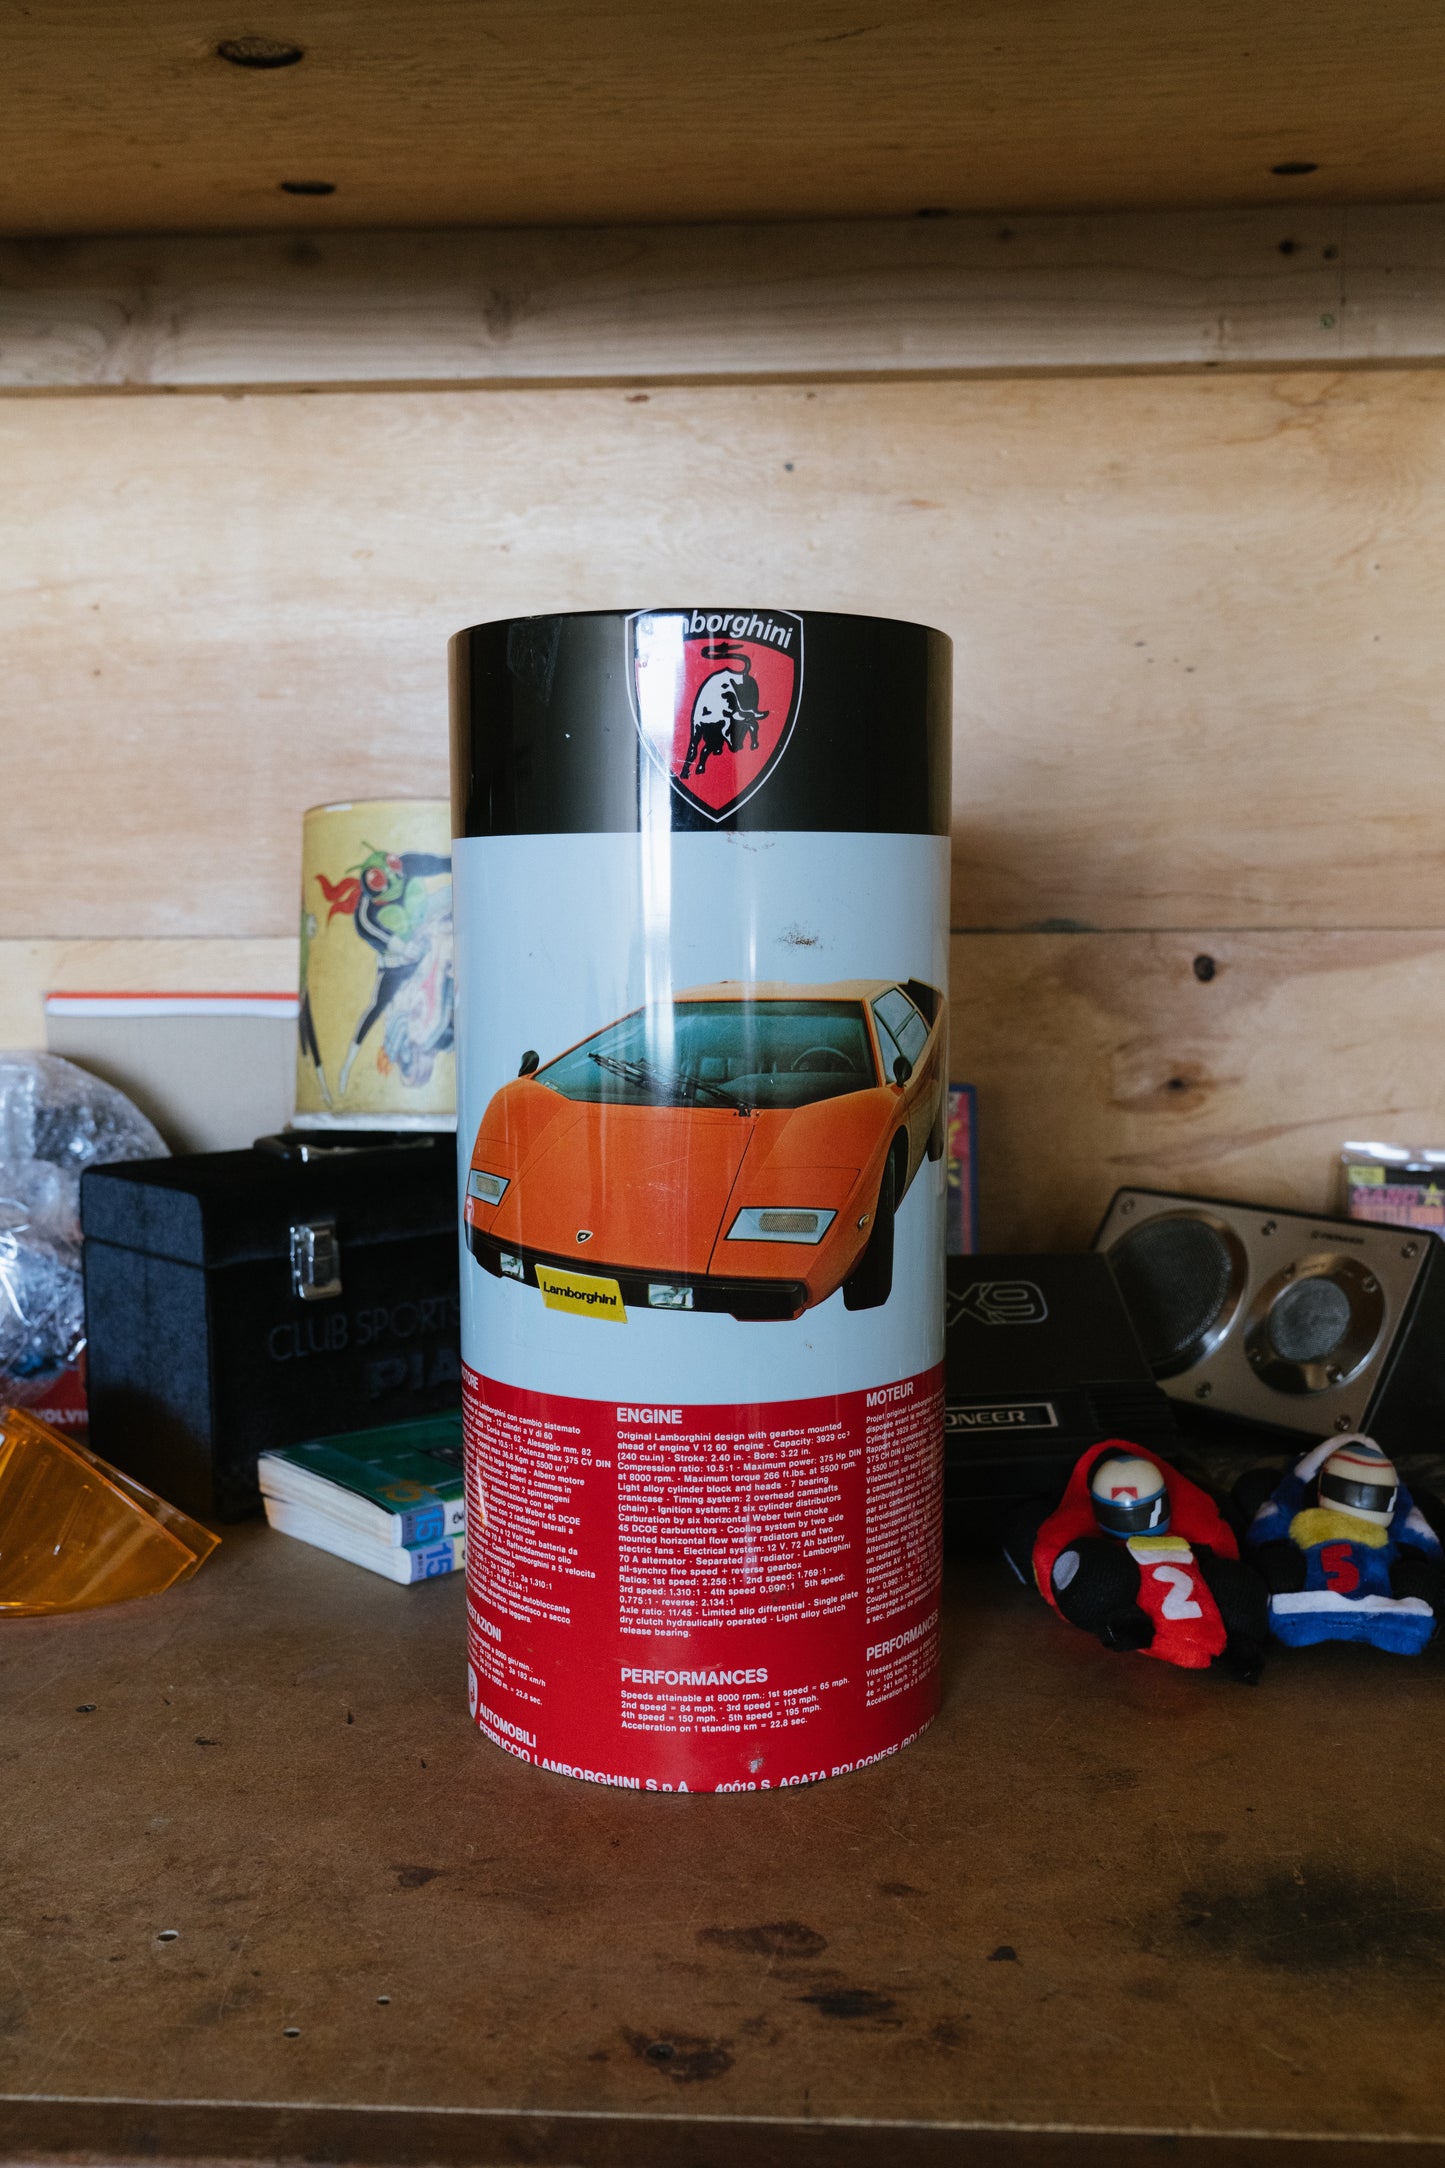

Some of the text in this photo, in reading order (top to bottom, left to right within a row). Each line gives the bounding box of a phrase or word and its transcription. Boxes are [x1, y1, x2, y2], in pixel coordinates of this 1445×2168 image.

[543, 1281, 617, 1305] Lamborghini
[268, 1312, 348, 1361] CLUB
[866, 1381, 913, 1407] MOTEUR
[617, 1407, 682, 1424] ENGINE
[617, 1422, 841, 1442] Original Lamborghini design with gearbox mounted
[617, 1442, 644, 1450] ahead
[703, 1443, 712, 1451] 12
[715, 1443, 726, 1451] 60
[733, 1442, 764, 1451] engine
[816, 1433, 834, 1443] 3929
[519, 1445, 545, 1458] Potenza
[564, 1455, 578, 1464] 375
[580, 1457, 592, 1466] CV
[596, 1459, 611, 1468] DIN
[617, 1462, 675, 1472] Compression
[743, 1462, 786, 1470] Maximum
[819, 1454, 833, 1463] 375
[836, 1452, 846, 1460] Hp
[849, 1448, 861, 1457] DIN
[533, 1469, 584, 1485] Albero motore
[629, 1473, 651, 1482] 8000
[731, 1474, 760, 1482] torque
[763, 1471, 779, 1480] 266
[820, 1463, 838, 1473] 5500
[617, 1482, 640, 1491] Light
[643, 1484, 664, 1493] alloy
[667, 1485, 703, 1493] cylinder
[735, 1483, 751, 1492] and
[755, 1482, 781, 1490] heads
[798, 1476, 828, 1486] bearing
[618, 1494, 663, 1502] crankcase
[673, 1495, 703, 1504] Timing
[746, 1494, 750, 1502] 2
[754, 1491, 794, 1501] overhead
[797, 1485, 838, 1497] camshafts
[658, 1505, 692, 1514] Ignition
[734, 1505, 739, 1513] 2
[742, 1504, 755, 1512] six
[758, 1501, 793, 1511] cylinder
[795, 1494, 841, 1507] distributors
[415, 1507, 443, 1541] 15
[618, 1513, 670, 1523] Carburation
[673, 1516, 684, 1524] by
[688, 1516, 700, 1524] six
[704, 1514, 749, 1524] horizontal
[752, 1513, 780, 1521] Weber
[804, 1507, 828, 1516] choke
[426, 1543, 452, 1578] 15
[1320, 1543, 1359, 1594] 5
[1152, 1565, 1203, 1620] 2
[620, 1626, 651, 1635] release
[866, 1608, 938, 1661] PERFORMANCES
[621, 1667, 768, 1685] PERFORMANCES
[621, 1690, 653, 1700] Speeds
[656, 1694, 701, 1702] attainable
[717, 1693, 739, 1702] 8000
[768, 1690, 779, 1698] 1st
[783, 1685, 808, 1696] speed
[819, 1681, 829, 1690] 65
[479, 1702, 536, 1748] AUTOMOBILI
[621, 1721, 676, 1731] Acceleration
[701, 1724, 740, 1732] standing
[534, 1754, 639, 1789] LAMBORGHINI
[779, 1770, 826, 1787] AGATA
